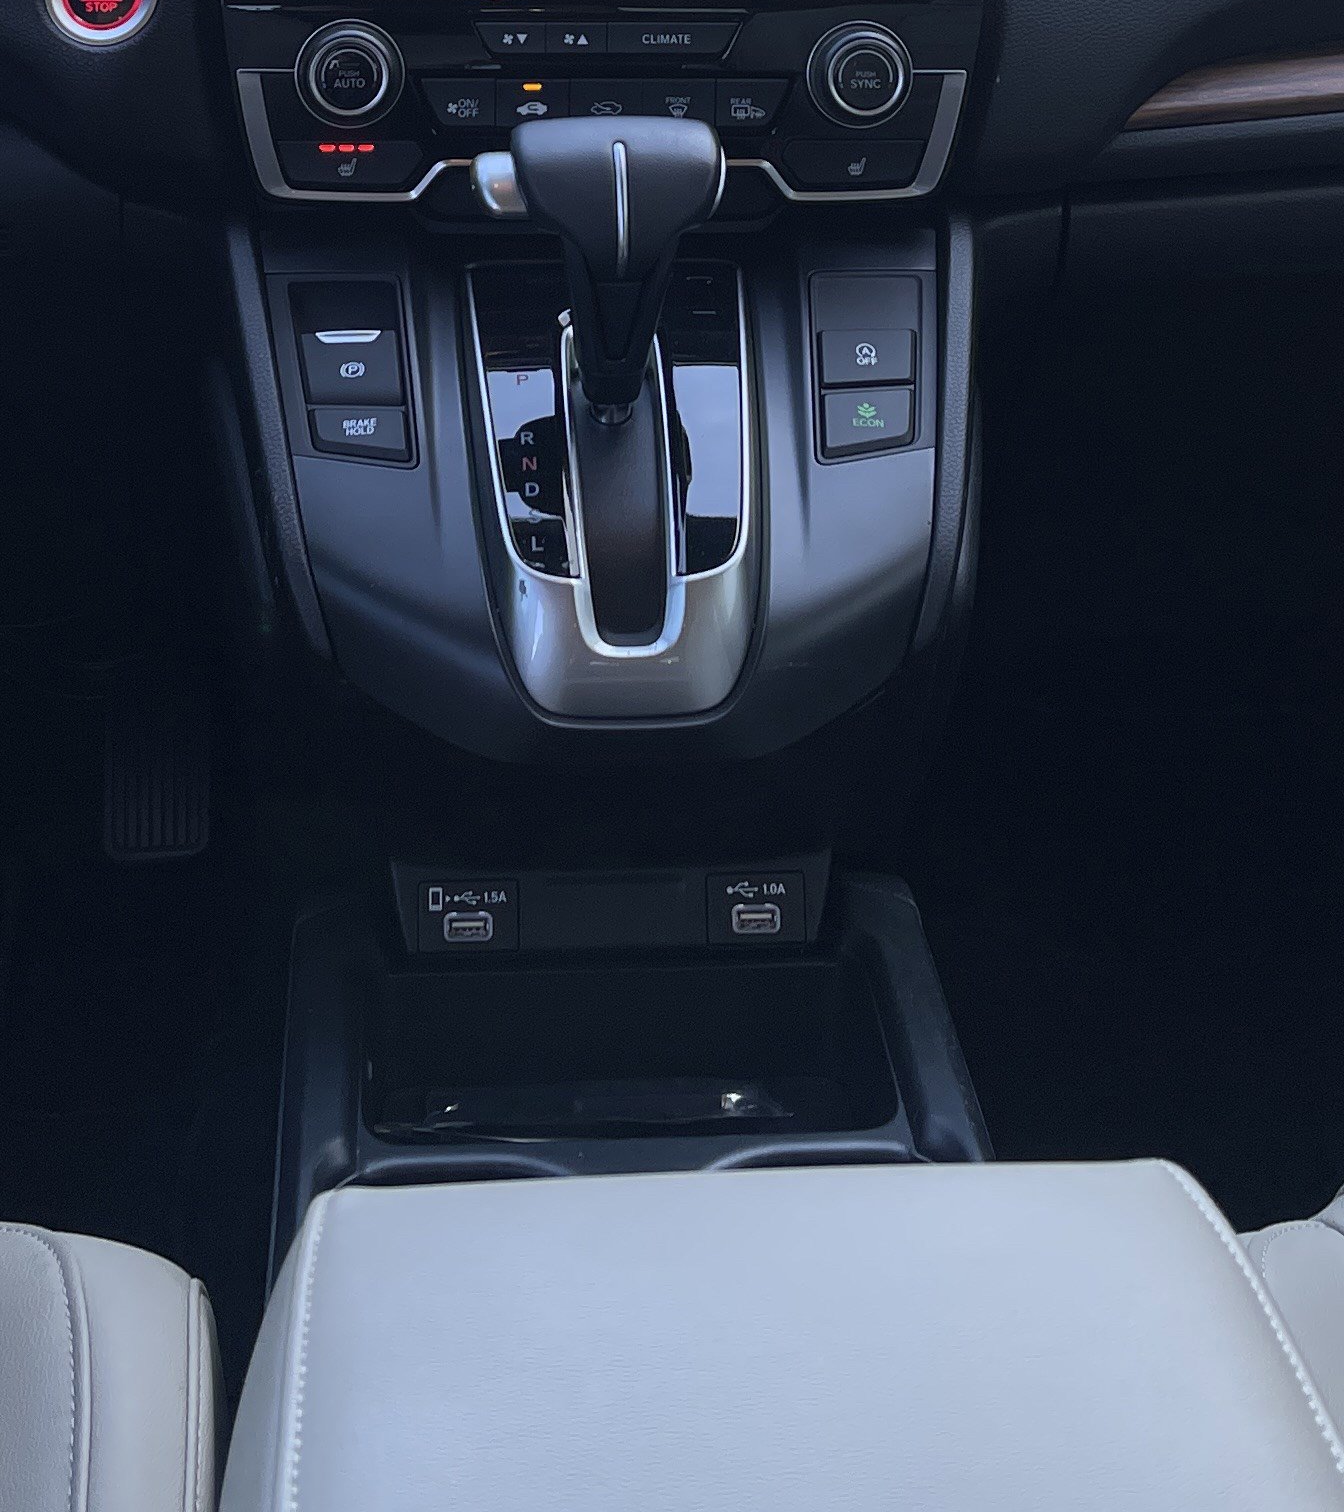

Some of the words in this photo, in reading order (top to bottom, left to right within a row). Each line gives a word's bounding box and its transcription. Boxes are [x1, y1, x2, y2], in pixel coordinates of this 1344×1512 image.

[85, 2, 118, 13] STOP
[641, 33, 692, 45] CLIMATE
[333, 78, 366, 88] AUTO
[850, 78, 882, 89] SYNC
[458, 98, 479, 109] ON/
[665, 96, 691, 104] FRONT
[730, 97, 752, 105] REAR
[458, 108, 479, 118] OFF
[856, 356, 878, 366] OFF
[516, 374, 529, 386] P
[342, 418, 377, 429] BRAKE
[852, 417, 885, 428] ECON
[345, 426, 375, 437] HOLD
[520, 431, 535, 445] R
[522, 456, 538, 472] N
[525, 481, 540, 497] D
[531, 535, 545, 552] L
[763, 882, 786, 895] 1.0A
